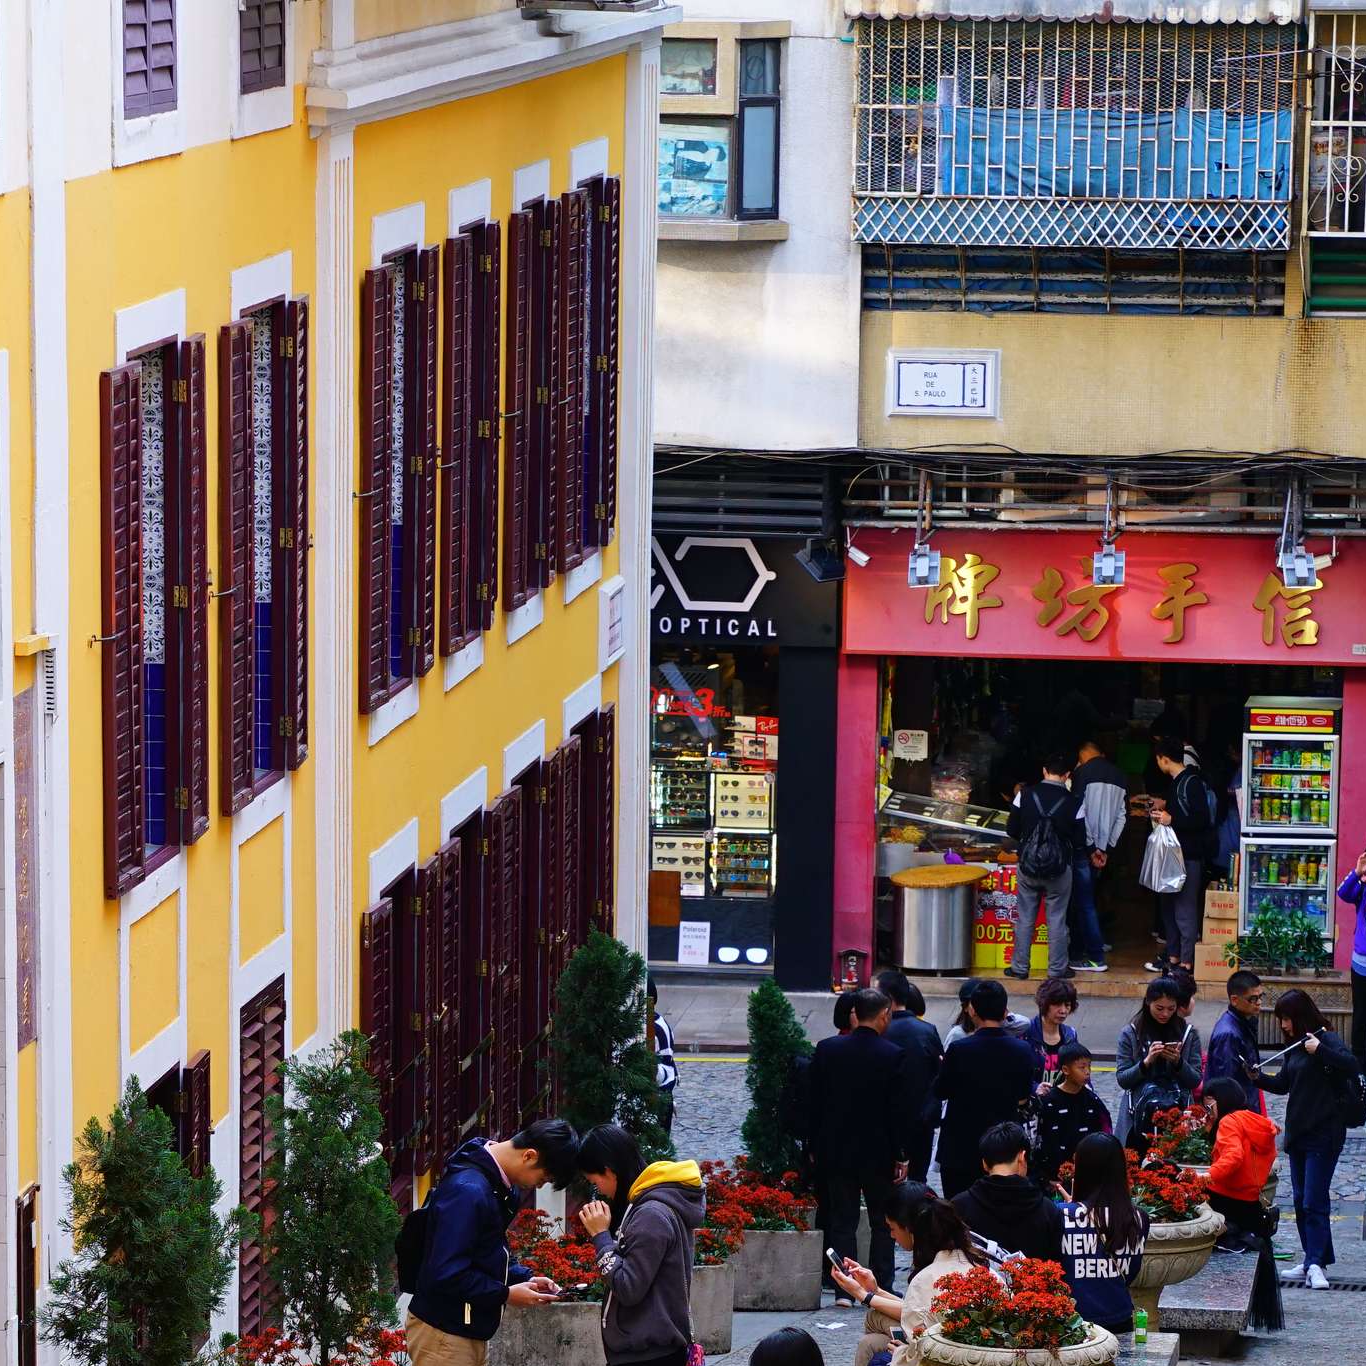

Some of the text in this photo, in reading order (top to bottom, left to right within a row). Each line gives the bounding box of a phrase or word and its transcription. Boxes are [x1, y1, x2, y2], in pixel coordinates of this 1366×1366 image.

[923, 371, 938, 379] RUA
[923, 390, 946, 398] PAULO
[659, 617, 777, 636] OPTICAL
[1061, 1233, 1098, 1255] NEW
[1074, 1257, 1132, 1279] BERLIN
